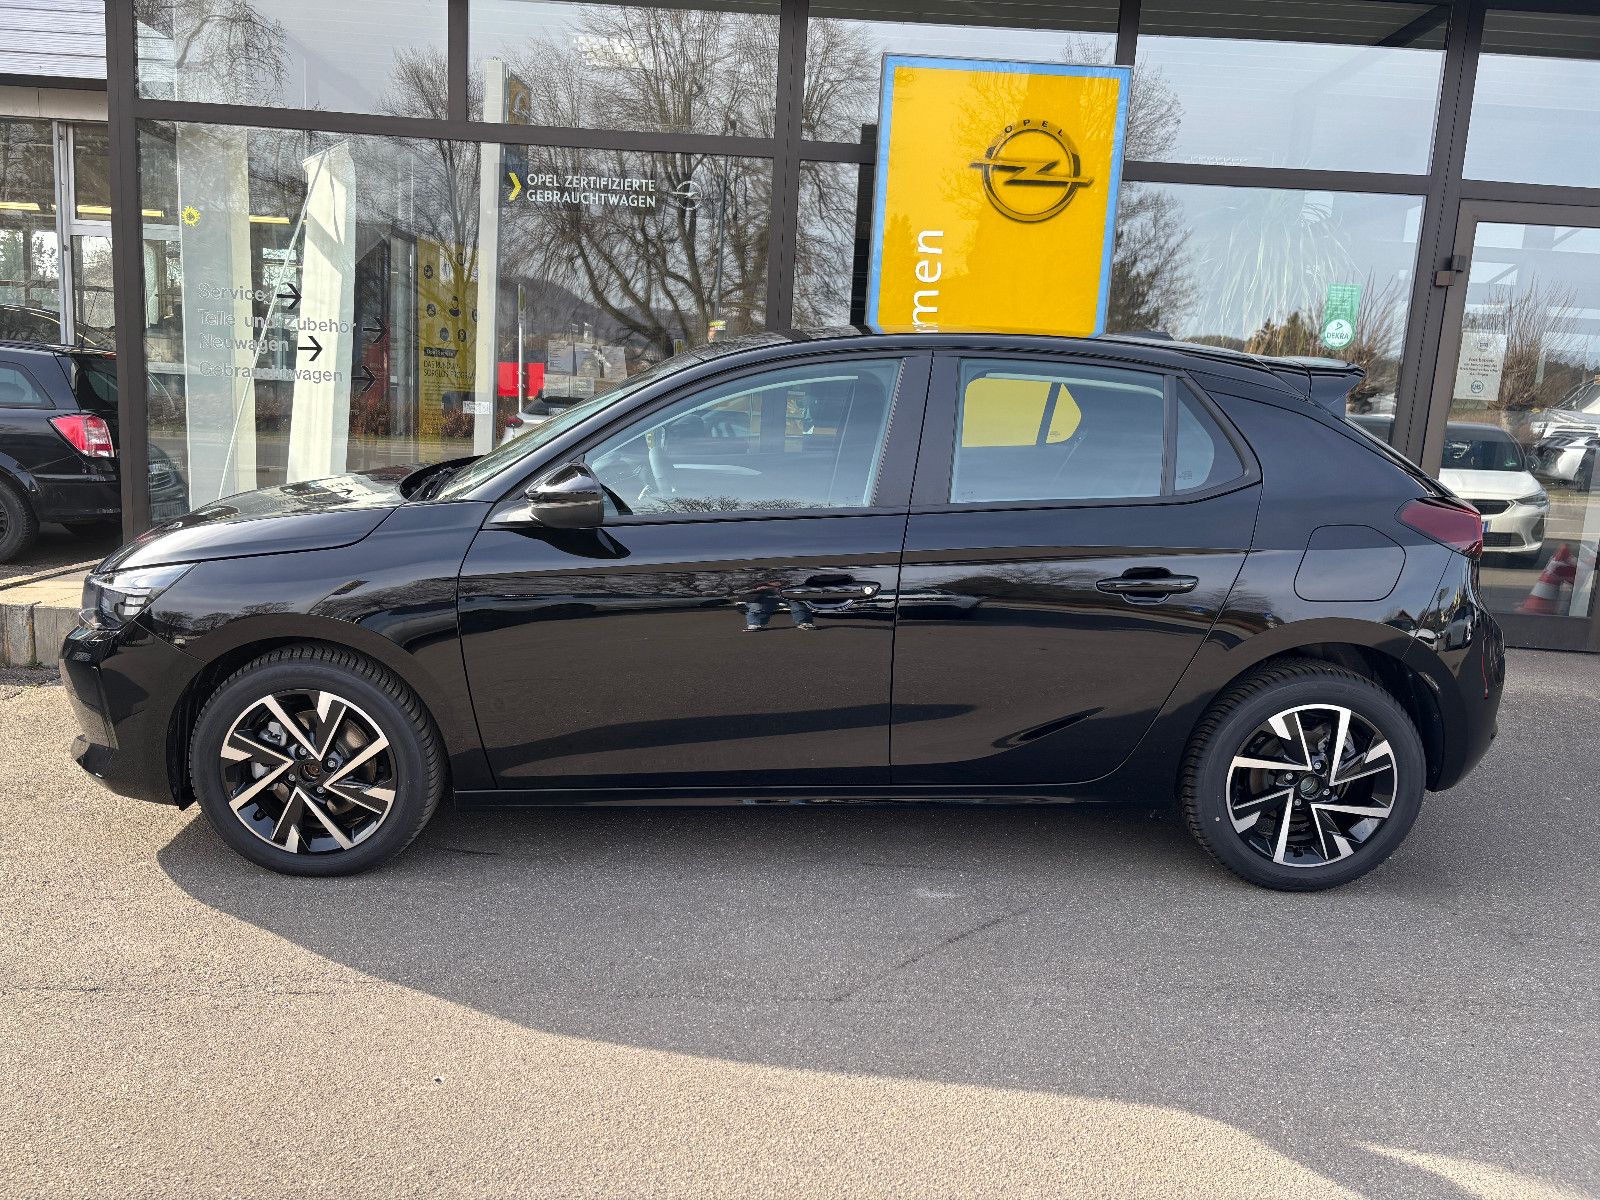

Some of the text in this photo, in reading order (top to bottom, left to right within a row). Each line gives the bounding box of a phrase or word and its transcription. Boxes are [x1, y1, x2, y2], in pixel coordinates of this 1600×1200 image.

[1004, 119, 1063, 137] OPEL
[526, 173, 656, 192] OPEL ZERTIFIZIERTE
[526, 190, 656, 208] GEBRAUCHTWAGEN
[198, 283, 267, 301] Service
[197, 308, 356, 334] Teile und Zubehör
[199, 332, 290, 353] Neuwagen
[1326, 332, 1349, 340] DEKRA
